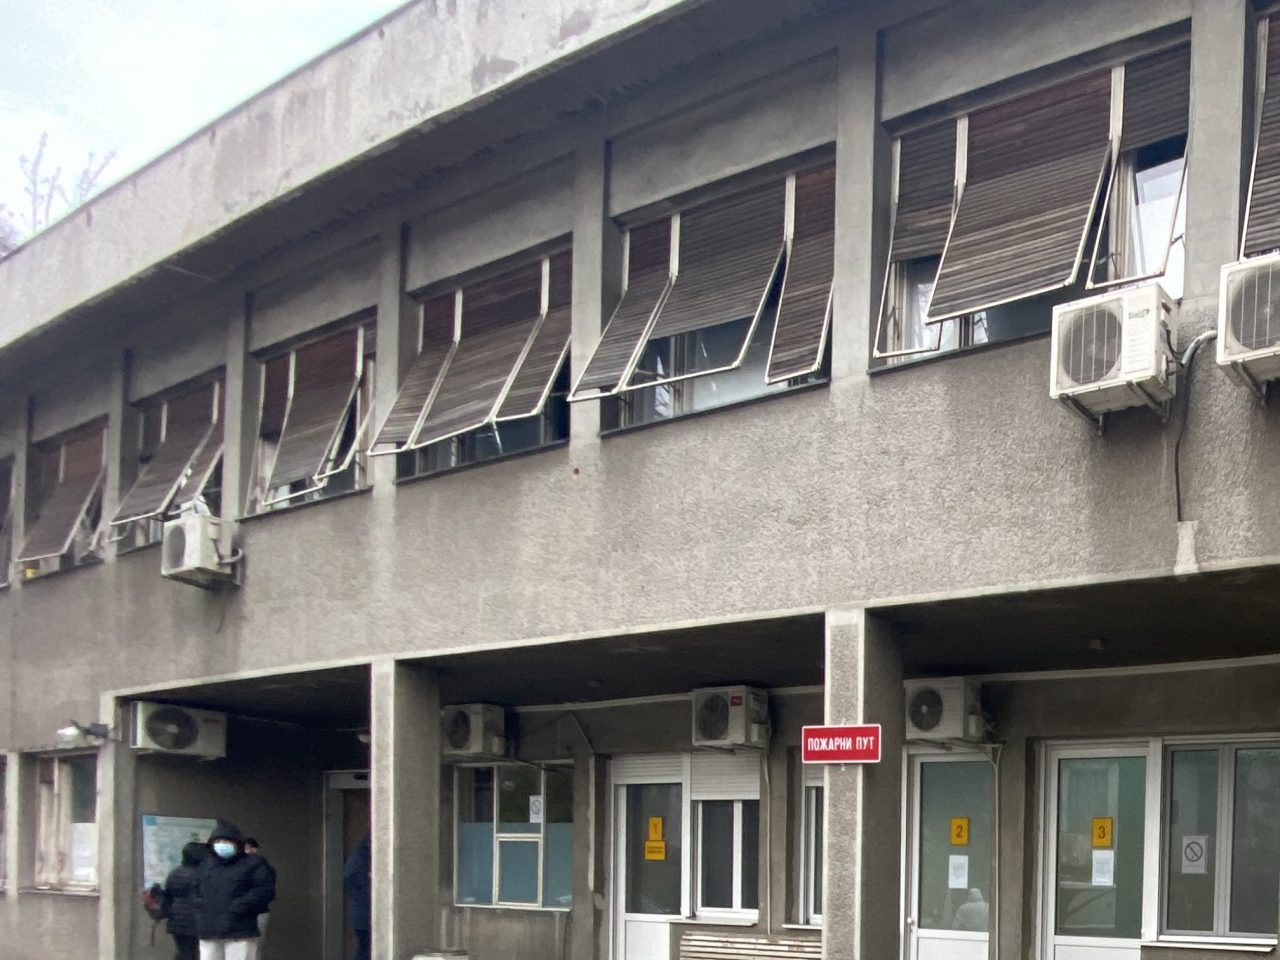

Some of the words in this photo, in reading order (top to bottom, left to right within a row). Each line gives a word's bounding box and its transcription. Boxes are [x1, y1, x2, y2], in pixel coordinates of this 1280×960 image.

[807, 737, 852, 751] ПОЖАРНИ
[855, 736, 875, 750] ПУТ
[955, 825, 964, 838] 2
[1098, 825, 1106, 839] 3
